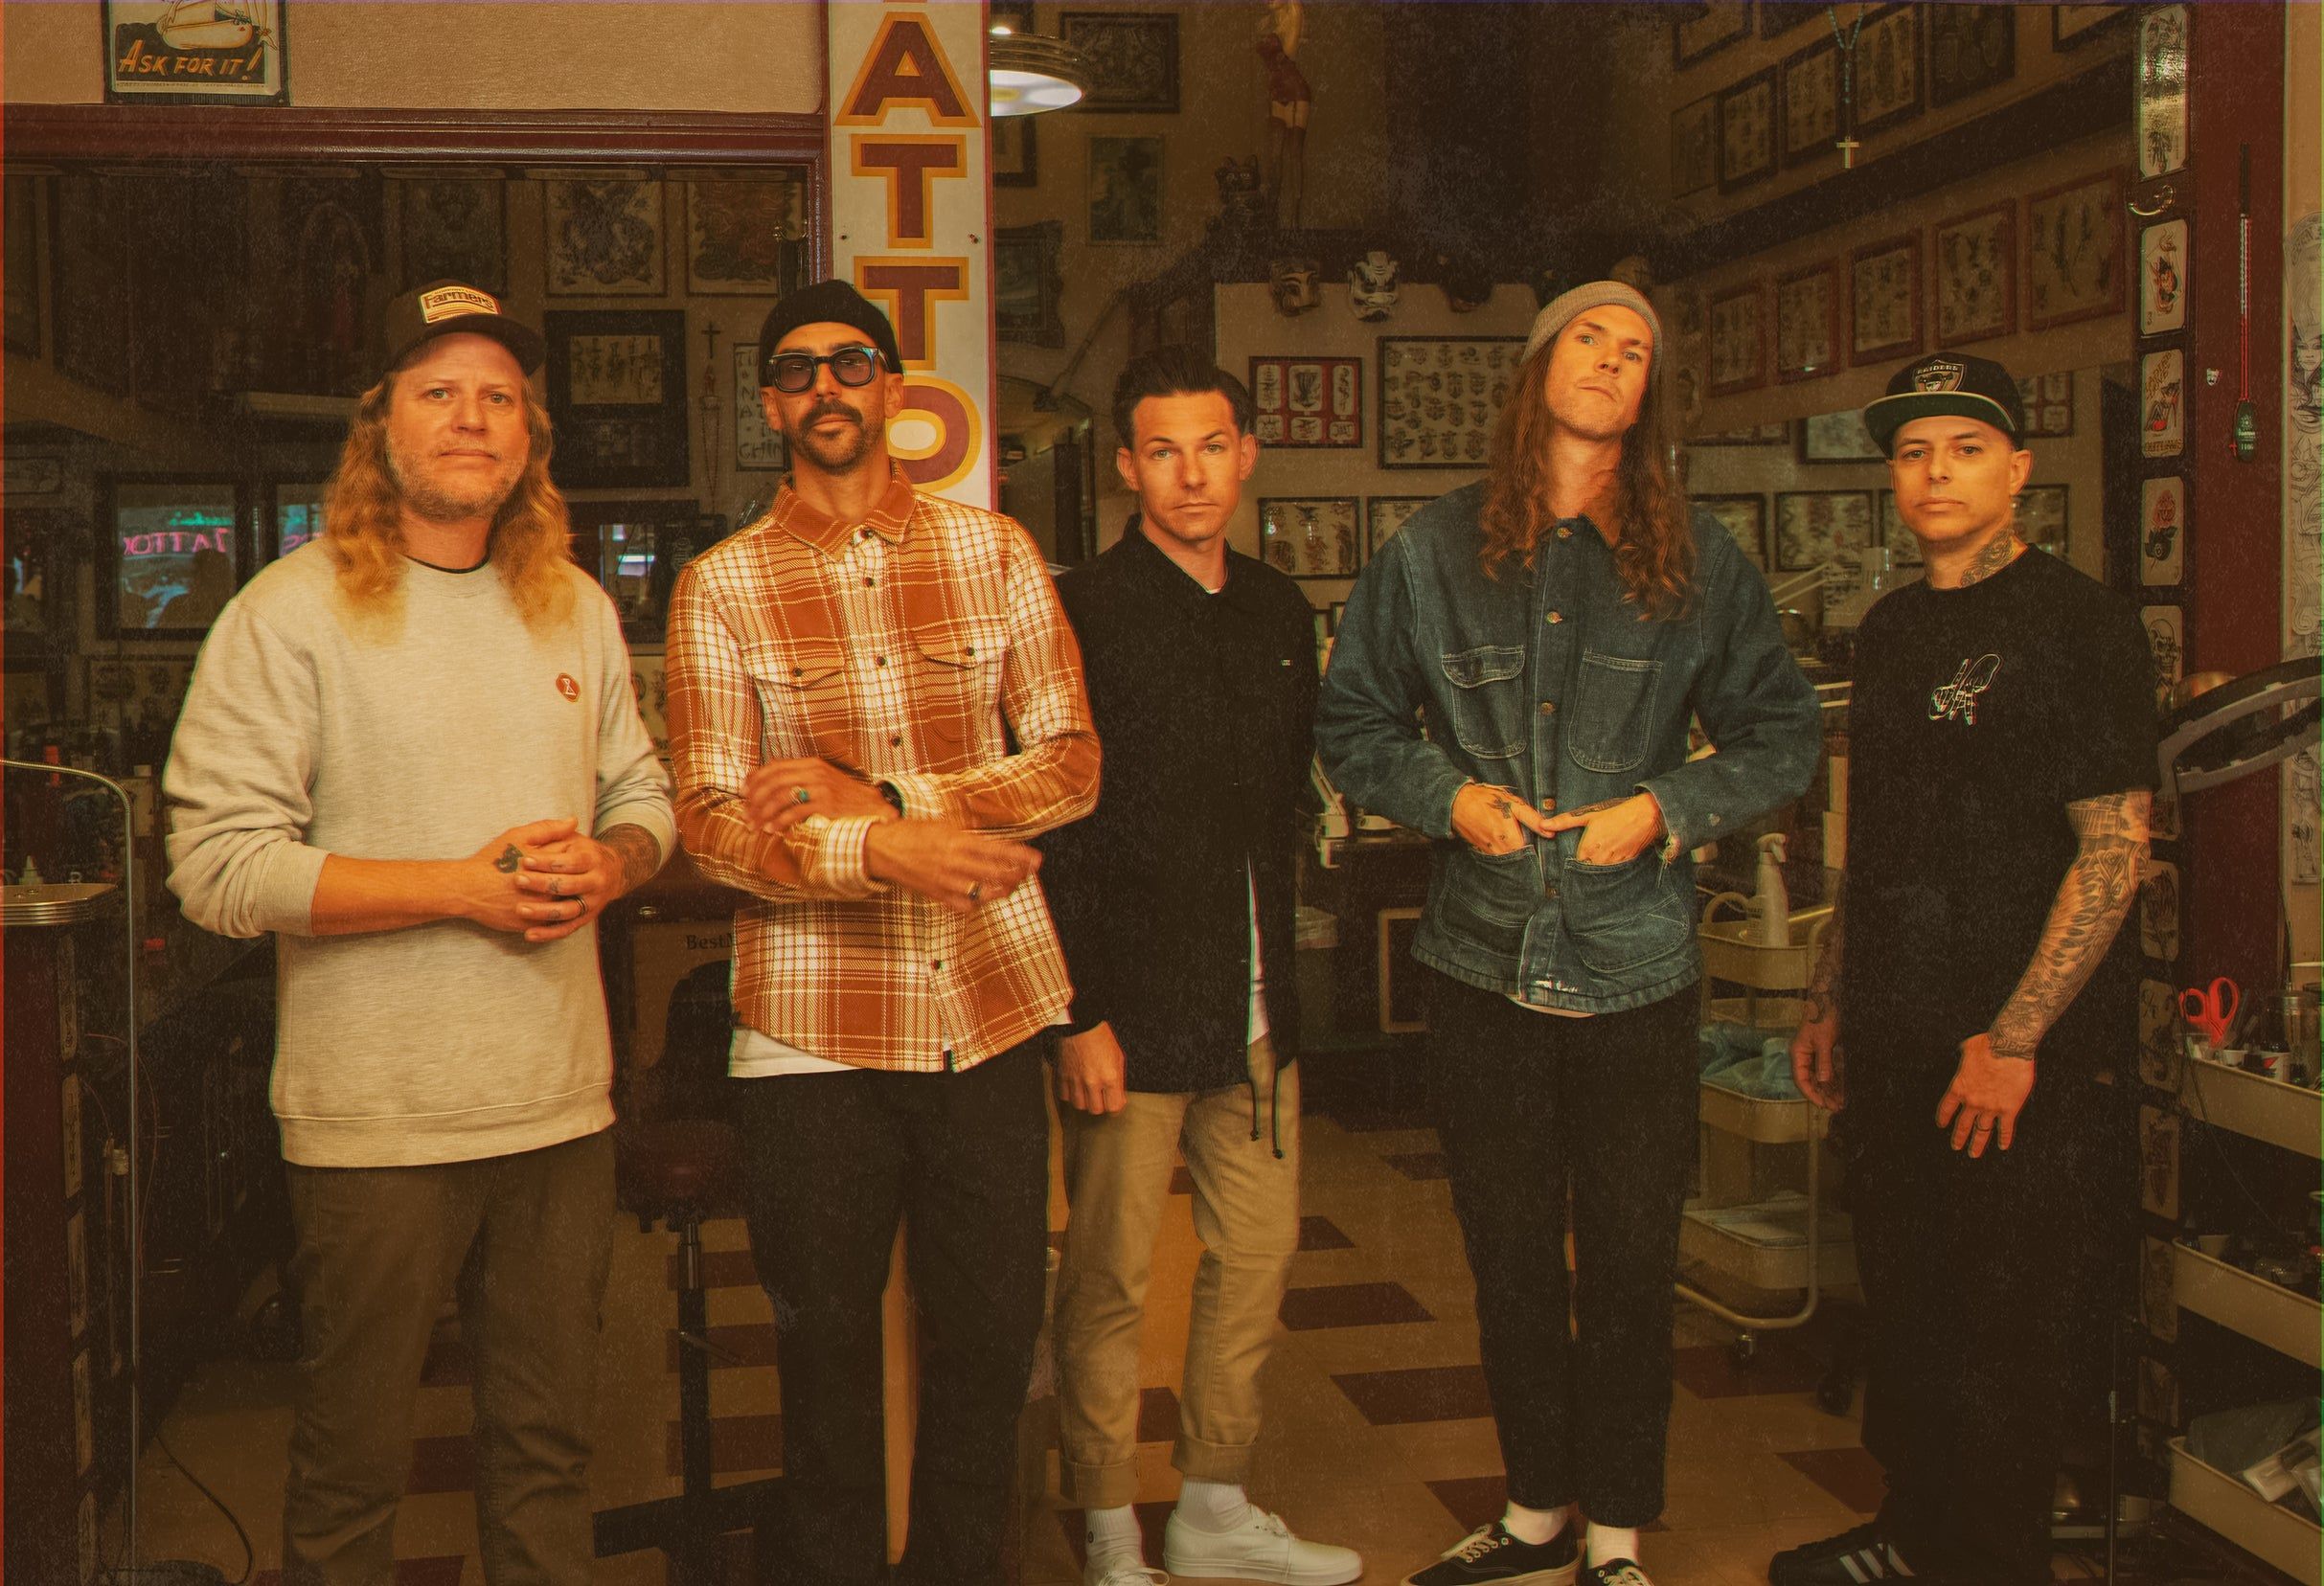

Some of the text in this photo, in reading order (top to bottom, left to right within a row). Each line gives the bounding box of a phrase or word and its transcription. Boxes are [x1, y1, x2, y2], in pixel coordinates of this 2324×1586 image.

[118, 39, 169, 77] ASK
[173, 57, 214, 77] FOR
[833, 0, 983, 493] ATTO
[423, 290, 495, 309] Farmers
[1917, 364, 1958, 375] RAIDERS
